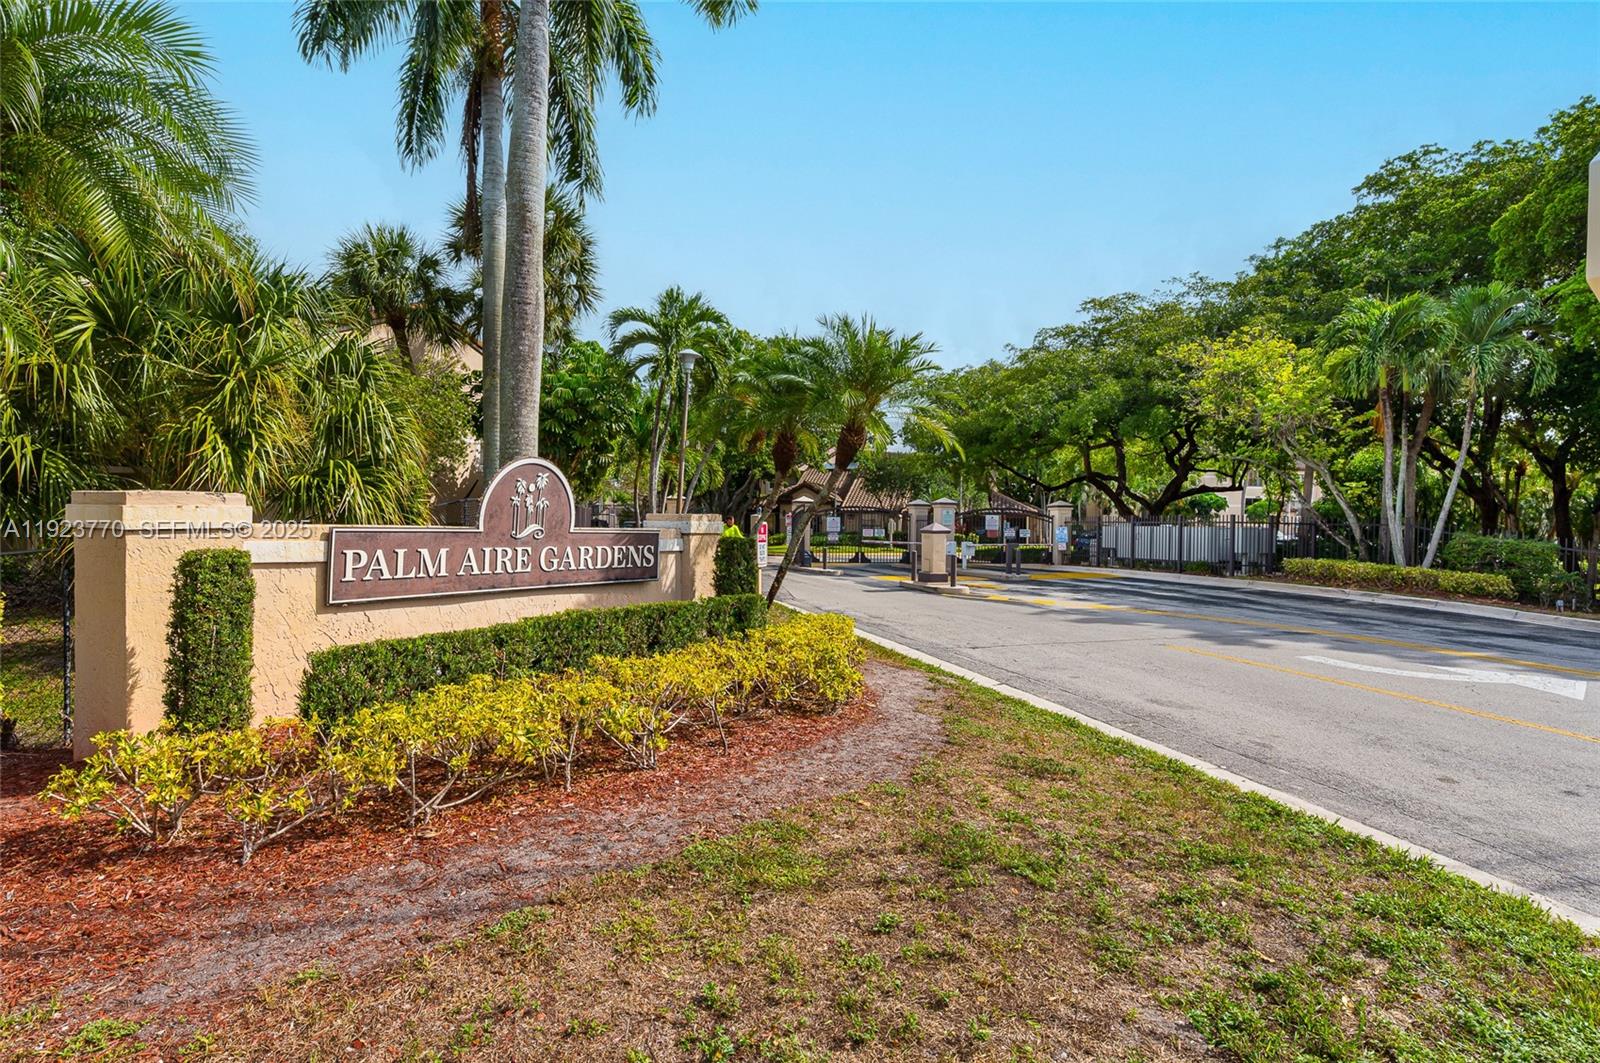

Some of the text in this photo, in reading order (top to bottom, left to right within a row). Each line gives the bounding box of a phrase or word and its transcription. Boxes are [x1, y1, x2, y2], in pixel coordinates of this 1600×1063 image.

[341, 544, 655, 582] PALM AIRE GARDENS
